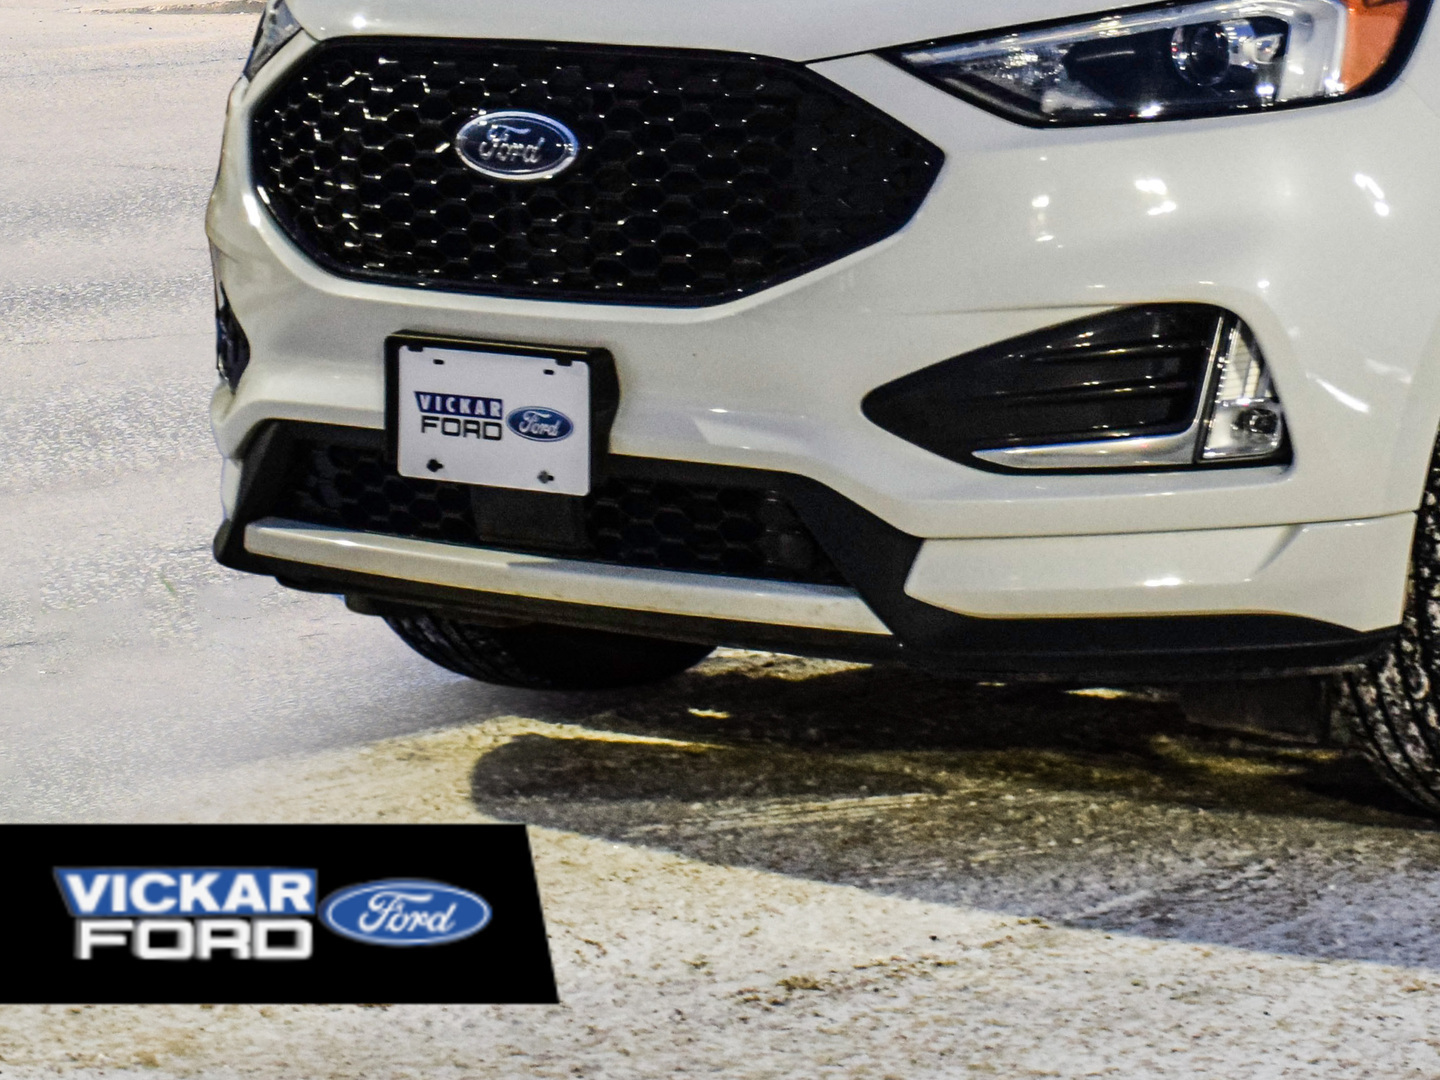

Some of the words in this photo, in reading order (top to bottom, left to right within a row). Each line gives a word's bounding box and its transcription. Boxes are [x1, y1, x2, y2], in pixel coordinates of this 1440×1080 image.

[479, 124, 547, 165] Ford
[418, 393, 503, 420] VICKAR
[421, 415, 503, 442] FORD
[518, 409, 560, 438] Ford
